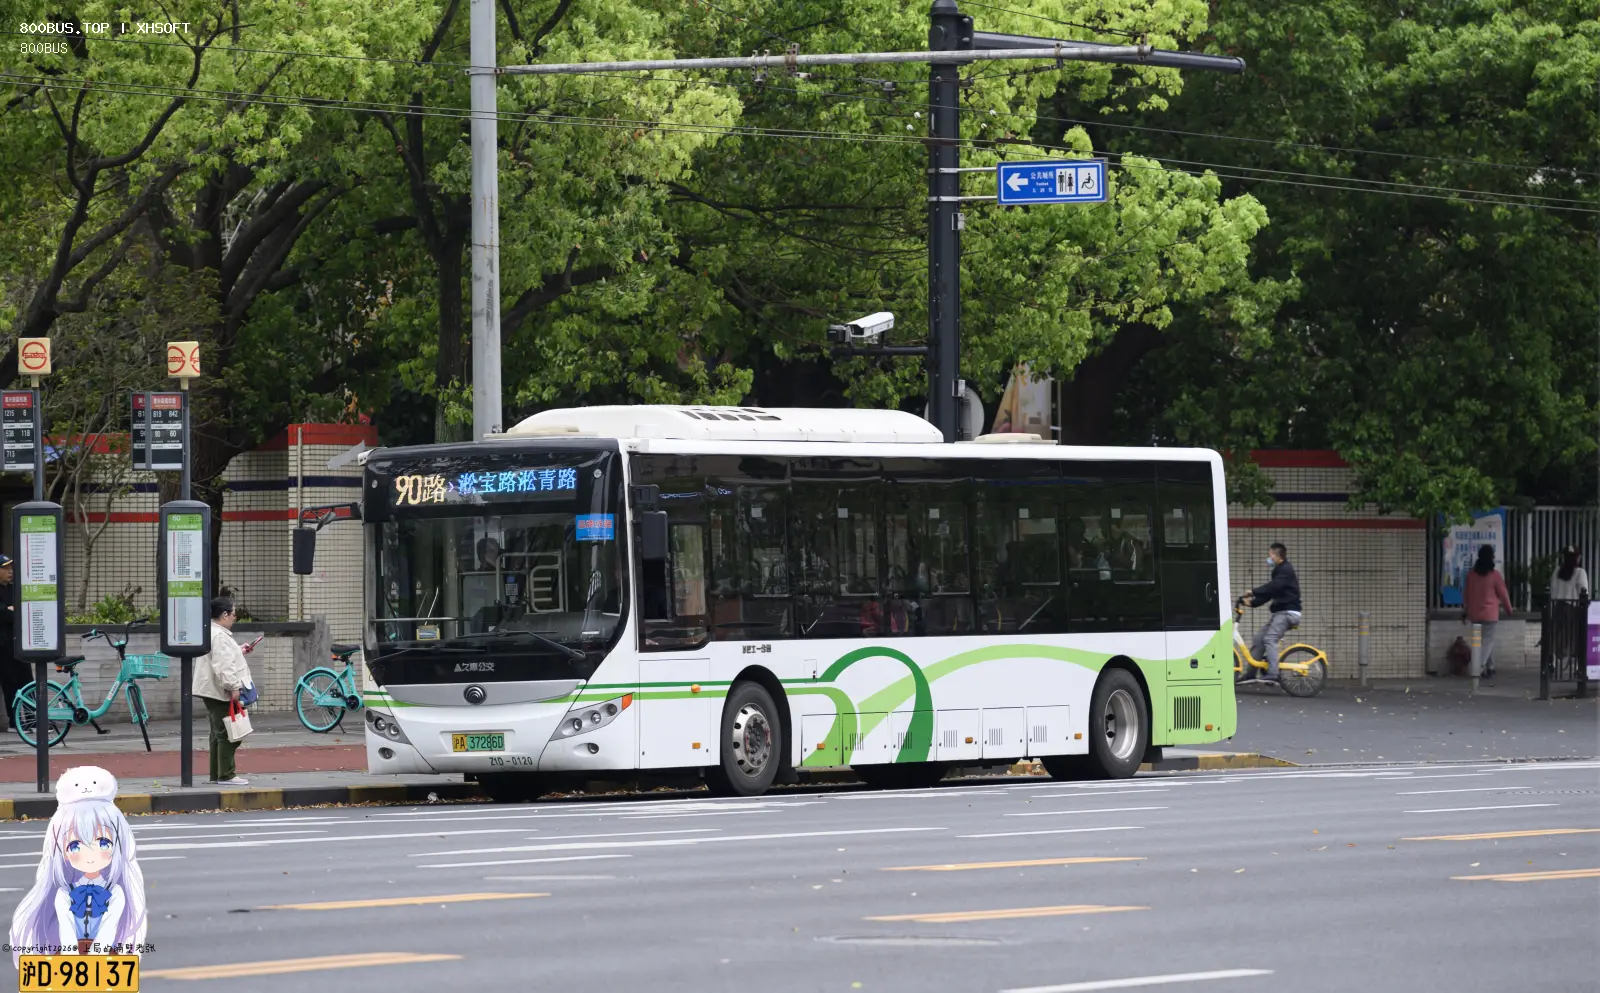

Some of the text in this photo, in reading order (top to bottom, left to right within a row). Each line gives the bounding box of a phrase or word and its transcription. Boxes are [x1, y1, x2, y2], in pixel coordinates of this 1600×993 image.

[4, 409, 27, 417] 1215 8
[168, 410, 178, 418] 842
[154, 429, 177, 438] 90 60
[6, 450, 16, 458] 713
[395, 468, 577, 506] 90路 淞宝路淞青路
[469, 735, 504, 749] 37286D
